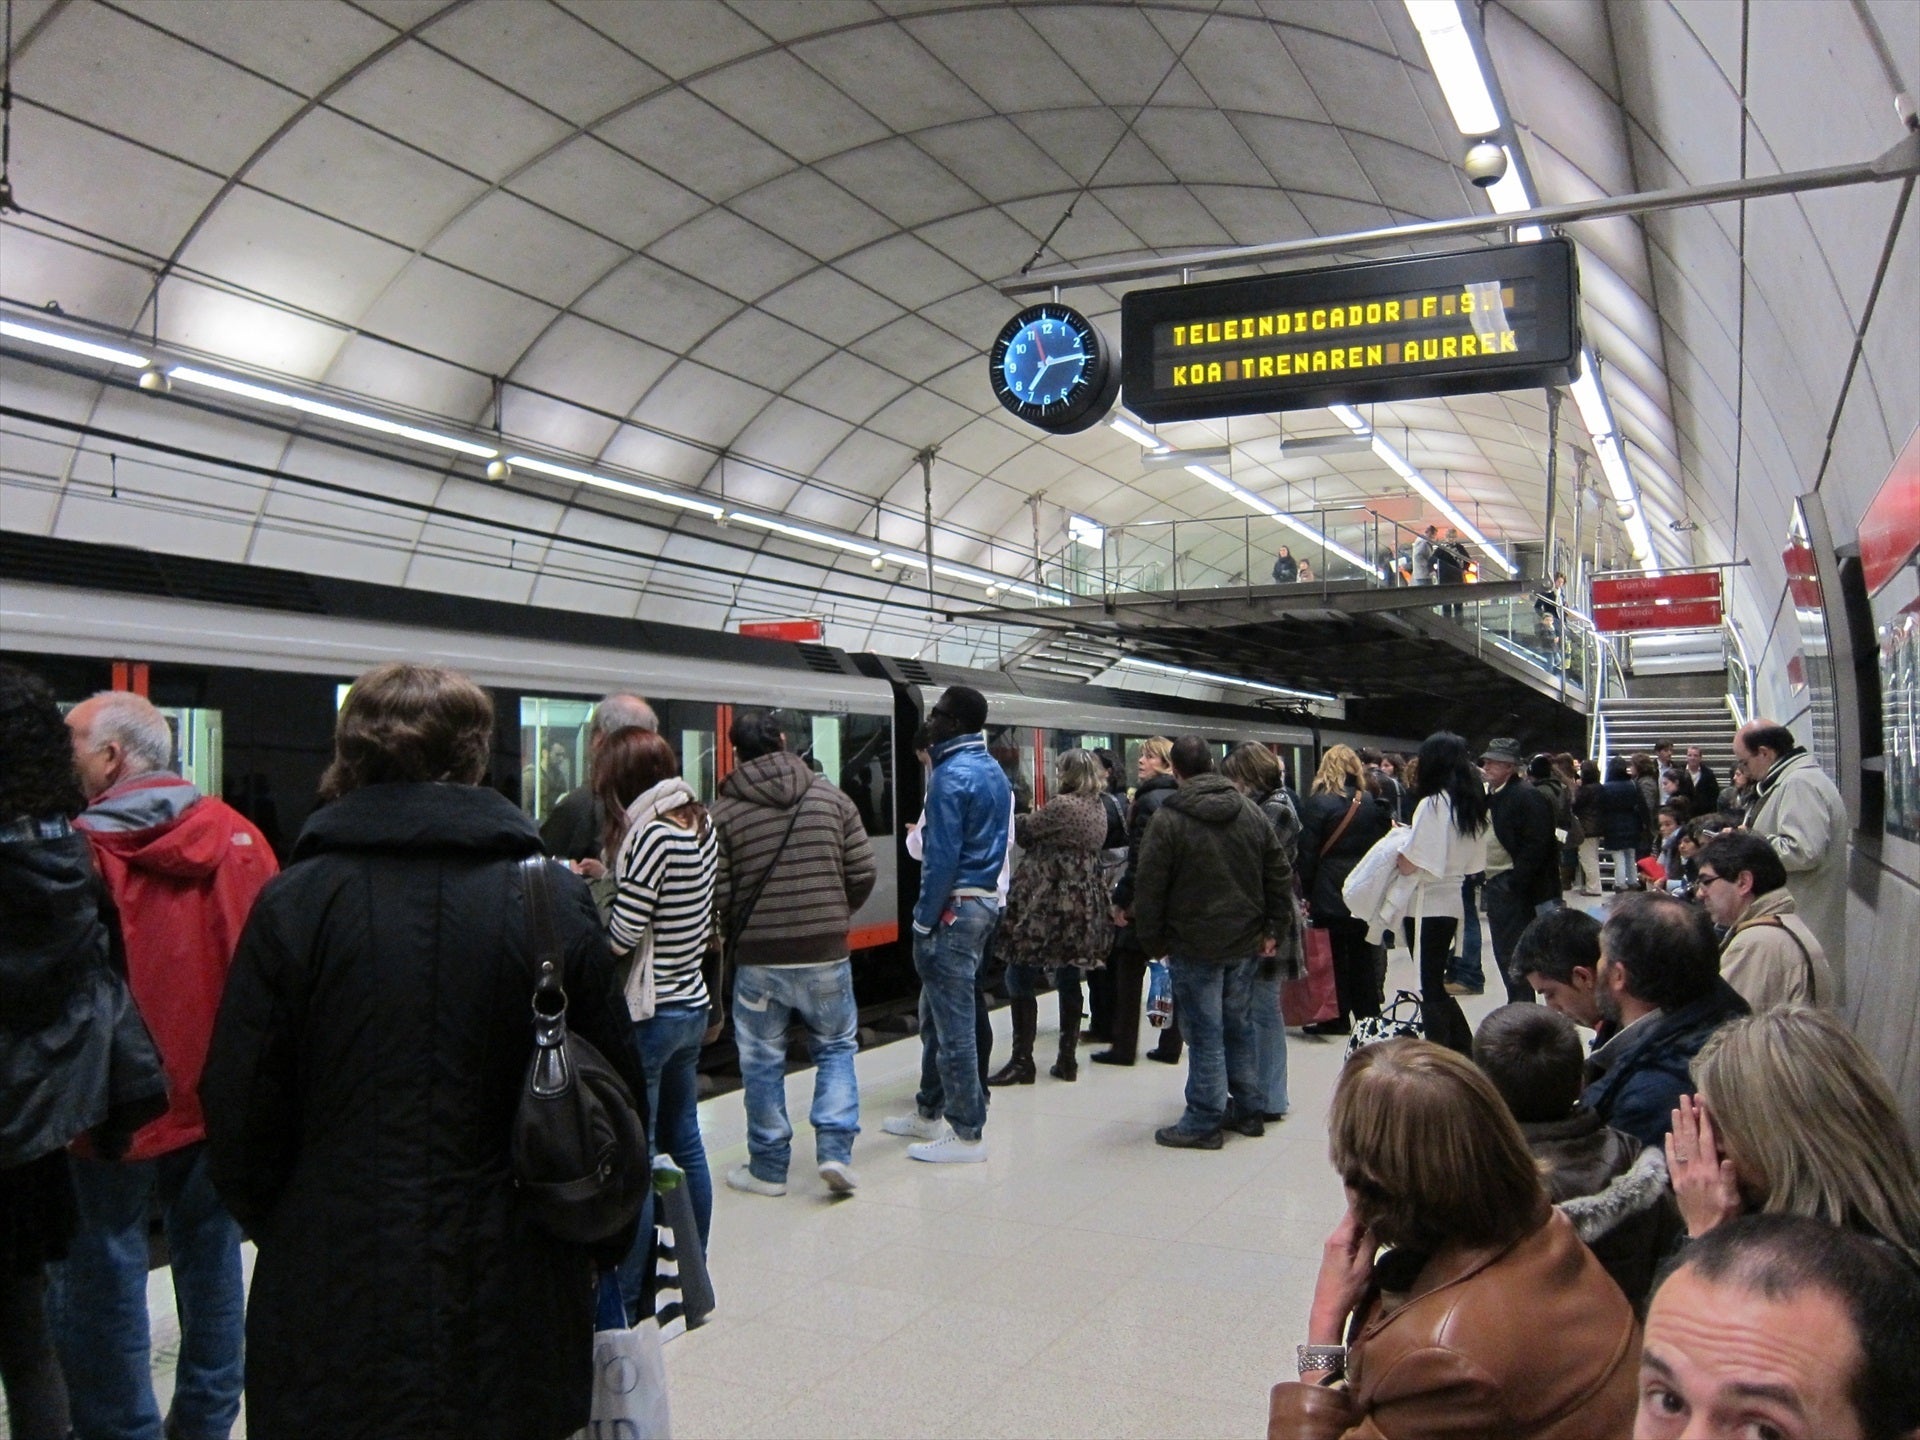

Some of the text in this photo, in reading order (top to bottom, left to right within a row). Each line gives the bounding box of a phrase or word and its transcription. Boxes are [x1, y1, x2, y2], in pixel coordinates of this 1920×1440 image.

[1173, 291, 1490, 346] TELEINDICADOR F.S.
[1041, 322, 1053, 335] 12
[1027, 330, 1036, 341] 11
[1073, 337, 1081, 348] 2
[1015, 343, 1027, 355] 10
[1173, 330, 1516, 387] KOA TRENAREN AURREK
[1009, 362, 1017, 374] 9
[1015, 380, 1023, 392] 8
[1027, 391, 1035, 402] 7
[1043, 394, 1051, 405] 6
